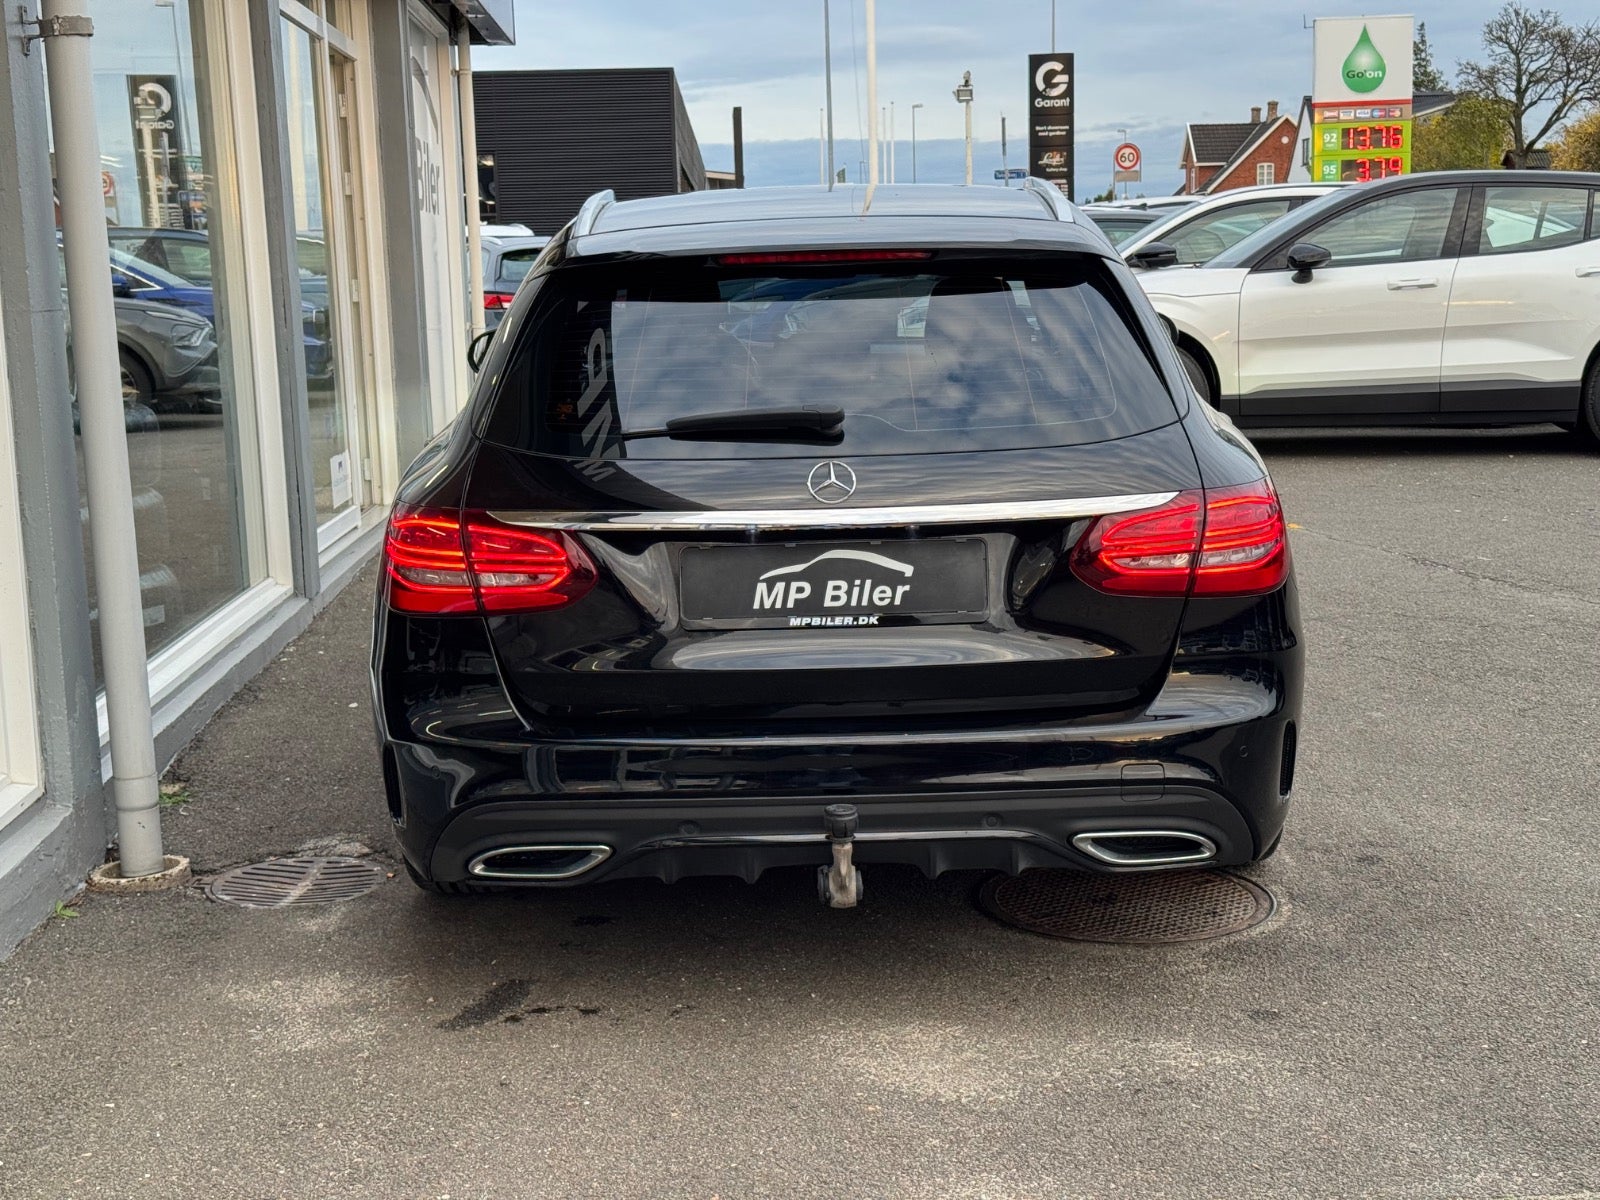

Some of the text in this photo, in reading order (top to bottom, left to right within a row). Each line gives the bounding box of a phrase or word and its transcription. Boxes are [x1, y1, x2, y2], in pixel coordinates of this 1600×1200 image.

[1346, 69, 1383, 79] Go'on
[1034, 97, 1070, 108] Garant
[1323, 133, 1337, 143] 92
[1119, 152, 1135, 163] 60
[1323, 165, 1337, 175] 95
[415, 137, 440, 216] Biler
[752, 579, 910, 610] MP Biler
[789, 615, 879, 627] MPBILER.DK
